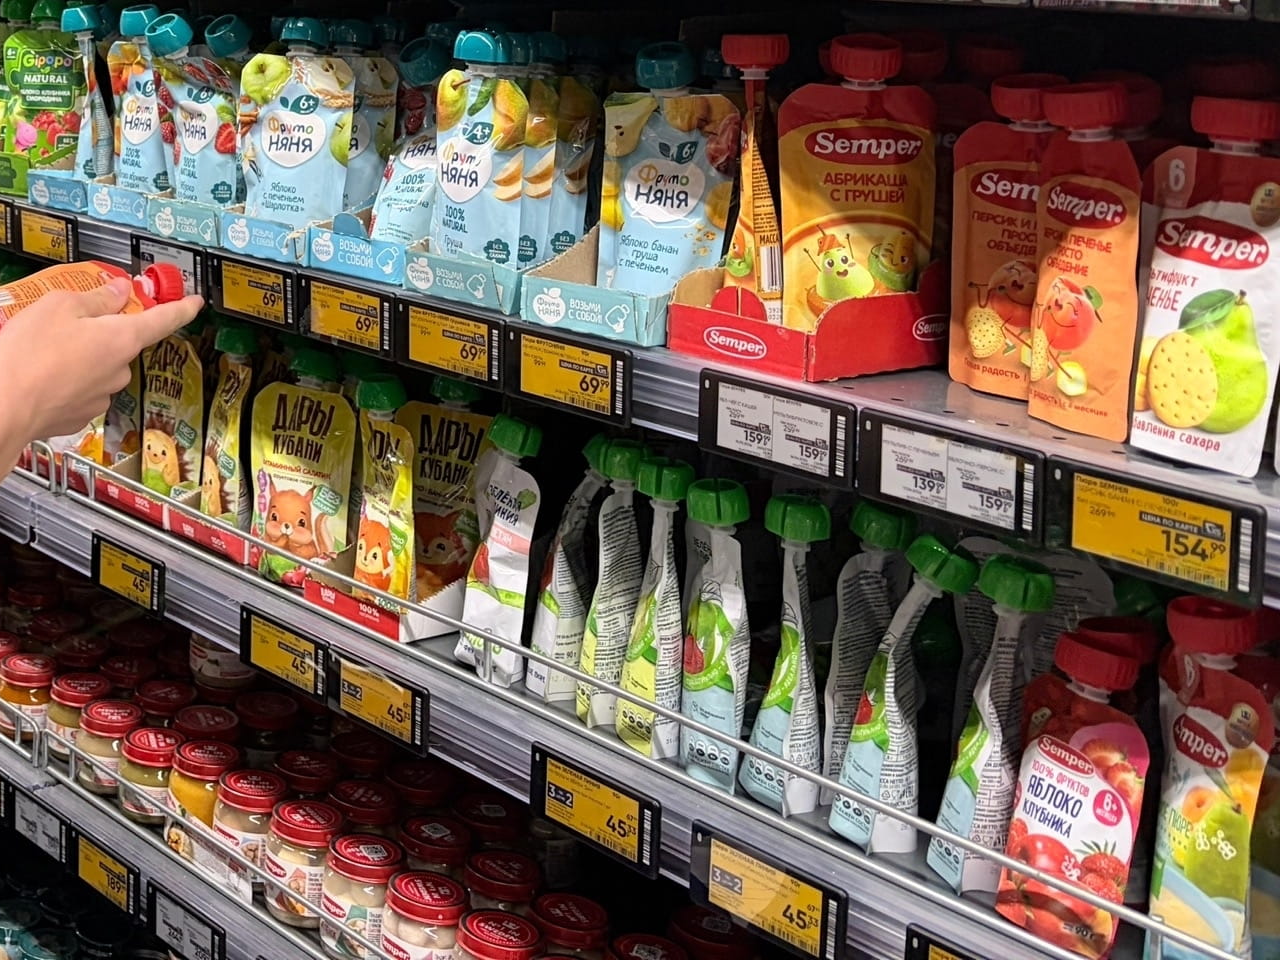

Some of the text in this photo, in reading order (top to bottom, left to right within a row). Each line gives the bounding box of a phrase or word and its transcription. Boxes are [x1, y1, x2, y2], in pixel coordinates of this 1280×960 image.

[22, 53, 73, 72] Gipopo
[23, 73, 69, 84] NATURAL
[299, 96, 316, 109] 6+
[123, 115, 152, 131] НЯНЯ
[268, 116, 313, 135] Фруто
[268, 137, 313, 153] НЯНЯ
[813, 132, 920, 158] Semper
[440, 167, 479, 188] НЯНЯ
[637, 164, 690, 188] Фруто
[270, 182, 297, 194] Яблоко
[634, 183, 690, 209] НЯНЯ
[845, 188, 906, 203] ГРУШЕЙ
[269, 194, 305, 205] печеньем
[1047, 186, 1122, 222] Semper
[444, 205, 466, 221] 100%
[339, 239, 372, 255] ВОЗЬМИ
[651, 241, 679, 256] банан
[1158, 220, 1265, 264] Semper
[631, 249, 659, 264] груша
[625, 259, 670, 276] печеньем
[262, 292, 276, 307] 69
[569, 298, 602, 313] ВОЗЬМИ
[356, 316, 371, 333] 69
[707, 329, 762, 355] Semper
[459, 344, 478, 362] 69
[579, 374, 600, 394] 69
[272, 393, 336, 441] ДАРЫ
[743, 430, 763, 445] 159
[1179, 431, 1221, 452] сахара
[273, 434, 324, 464] КУБАНИ
[799, 444, 819, 459] 159
[912, 475, 935, 492] 139
[978, 494, 1002, 512] 159
[1161, 529, 1209, 563] 154
[1176, 721, 1224, 763] mper
[1039, 736, 1092, 775] Semper
[1031, 759, 1091, 798] 100% ФРУКТОВ
[1027, 774, 1083, 820] ЯБЛОКО
[606, 814, 628, 838] 45
[1022, 797, 1073, 839] КЛУБНИКА
[782, 904, 808, 931] 45
